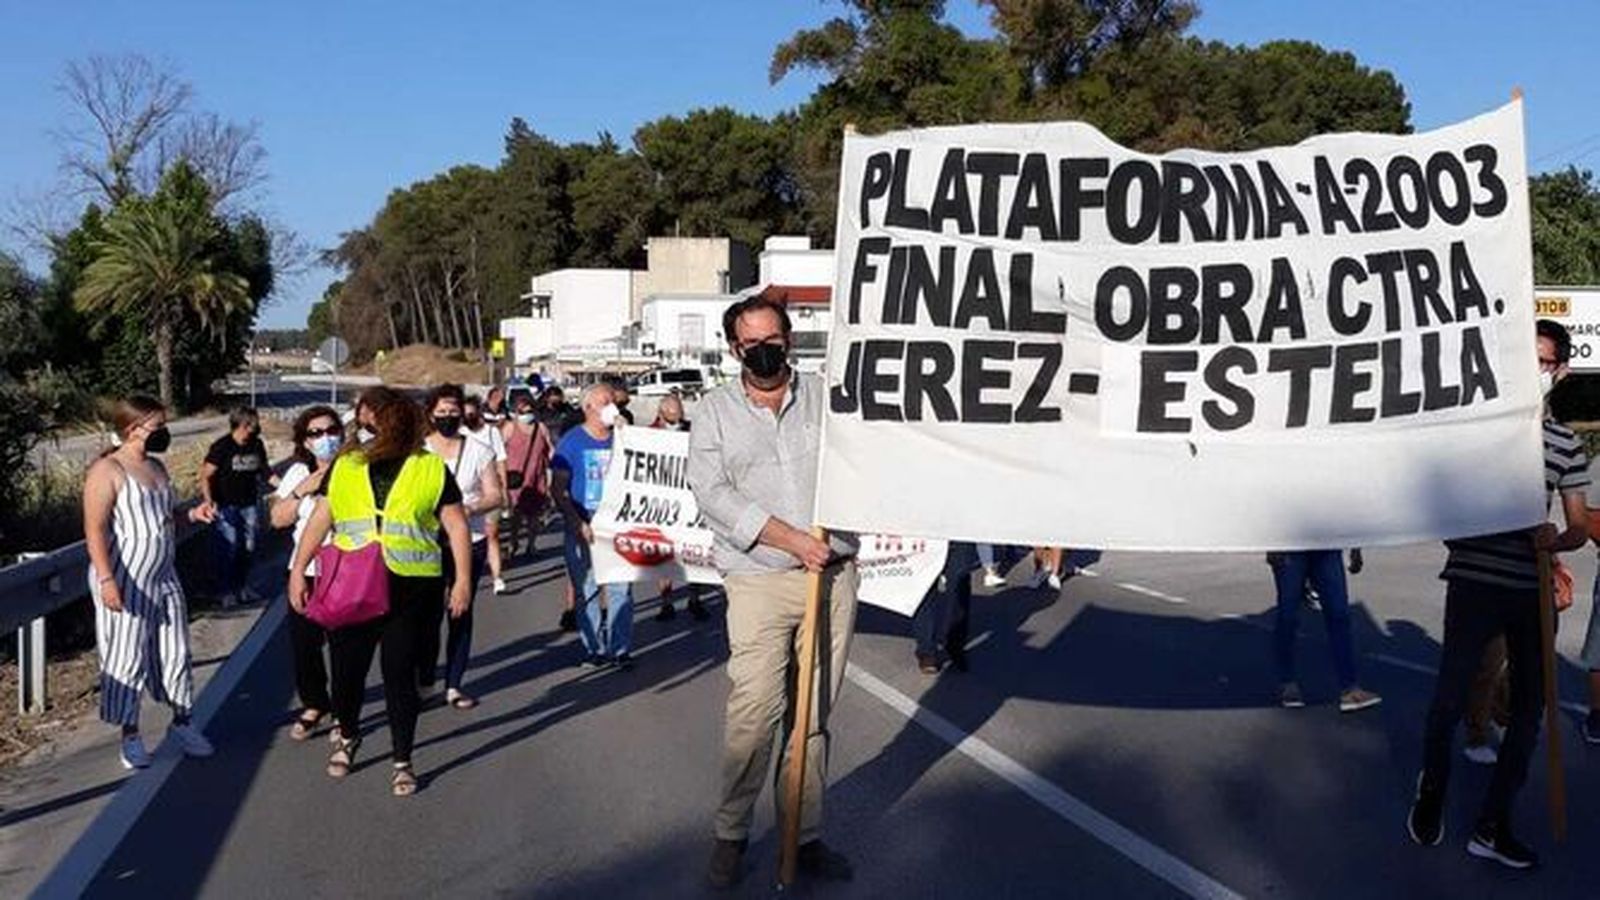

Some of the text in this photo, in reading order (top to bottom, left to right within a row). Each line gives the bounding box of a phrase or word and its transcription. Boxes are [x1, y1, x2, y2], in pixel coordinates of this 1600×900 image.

[848, 237, 1505, 346] FINAL OBRA CTRA.
[1137, 326, 1499, 433] ESTELLA
